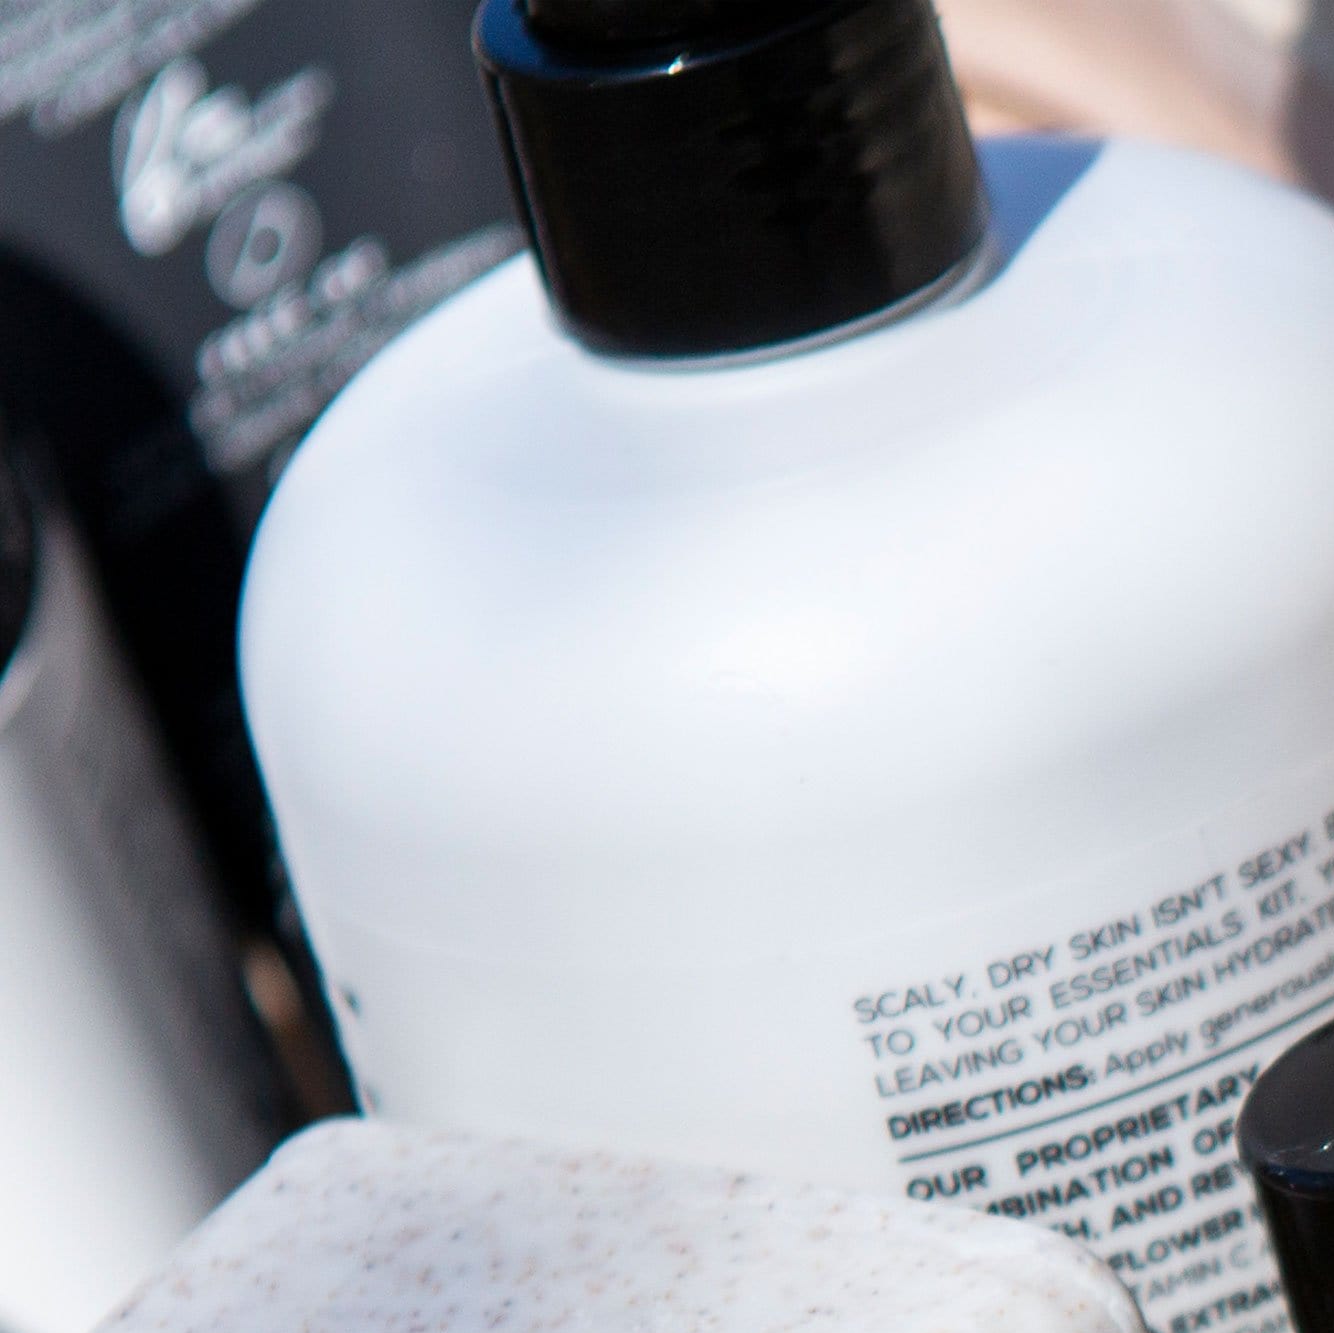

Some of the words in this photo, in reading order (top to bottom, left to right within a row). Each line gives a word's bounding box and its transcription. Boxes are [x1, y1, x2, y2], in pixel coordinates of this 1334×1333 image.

[864, 1029, 916, 1058] TO
[931, 995, 1031, 1042] YOUR
[1049, 910, 1244, 1010] ESSENTIALS
[987, 946, 1054, 990] DRY
[1069, 914, 1141, 960] SKIN
[1151, 873, 1225, 928] ISN'T
[874, 1039, 1024, 1098] LEAVING
[1032, 1002, 1128, 1050] YOUR
[1135, 968, 1206, 1017] SKIN
[886, 1063, 1097, 1141] DIRECTIONS:
[1105, 1031, 1189, 1078] Apply
[906, 1164, 987, 1202] OUR
[1015, 1062, 1259, 1178] PROPRIETARY
[1192, 1118, 1238, 1156] OF
[1111, 1185, 1184, 1232] AND
